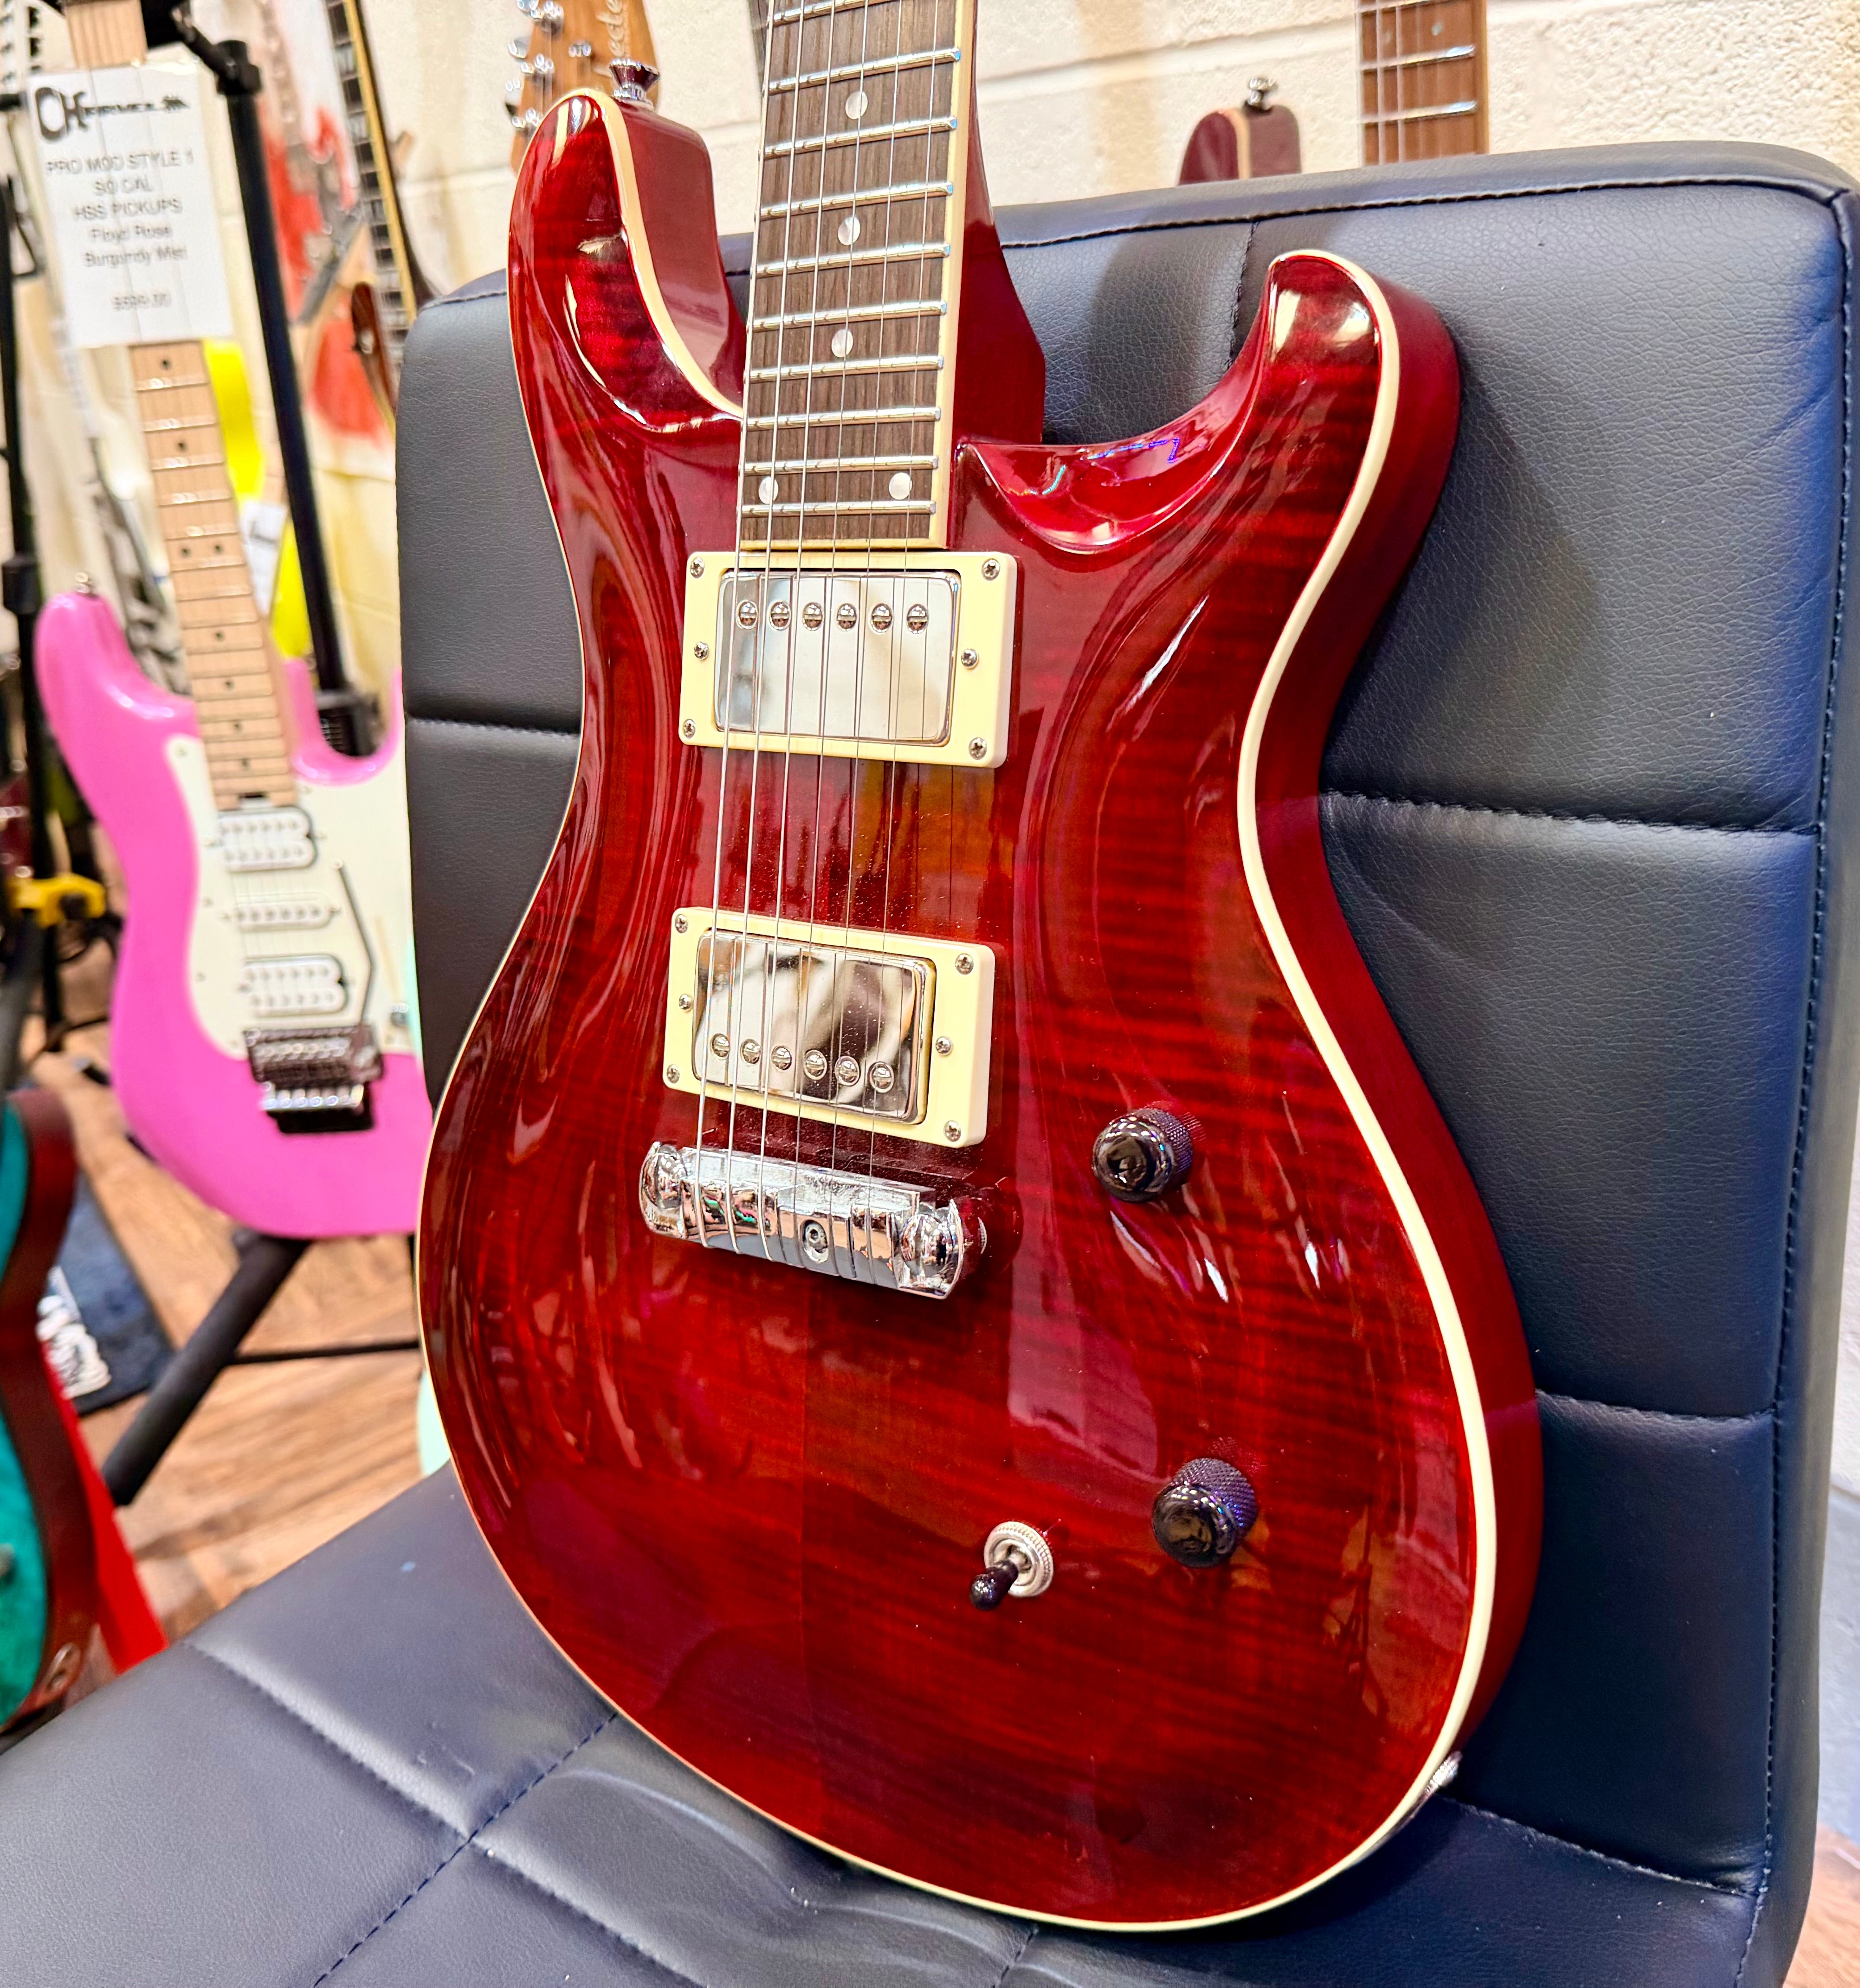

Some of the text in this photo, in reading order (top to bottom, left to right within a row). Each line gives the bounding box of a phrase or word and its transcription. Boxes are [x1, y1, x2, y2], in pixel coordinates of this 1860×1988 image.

[46, 159, 83, 175] PRO
[86, 154, 125, 173] MOD
[126, 148, 182, 171] STYLE
[112, 196, 183, 219] PICKUPS
